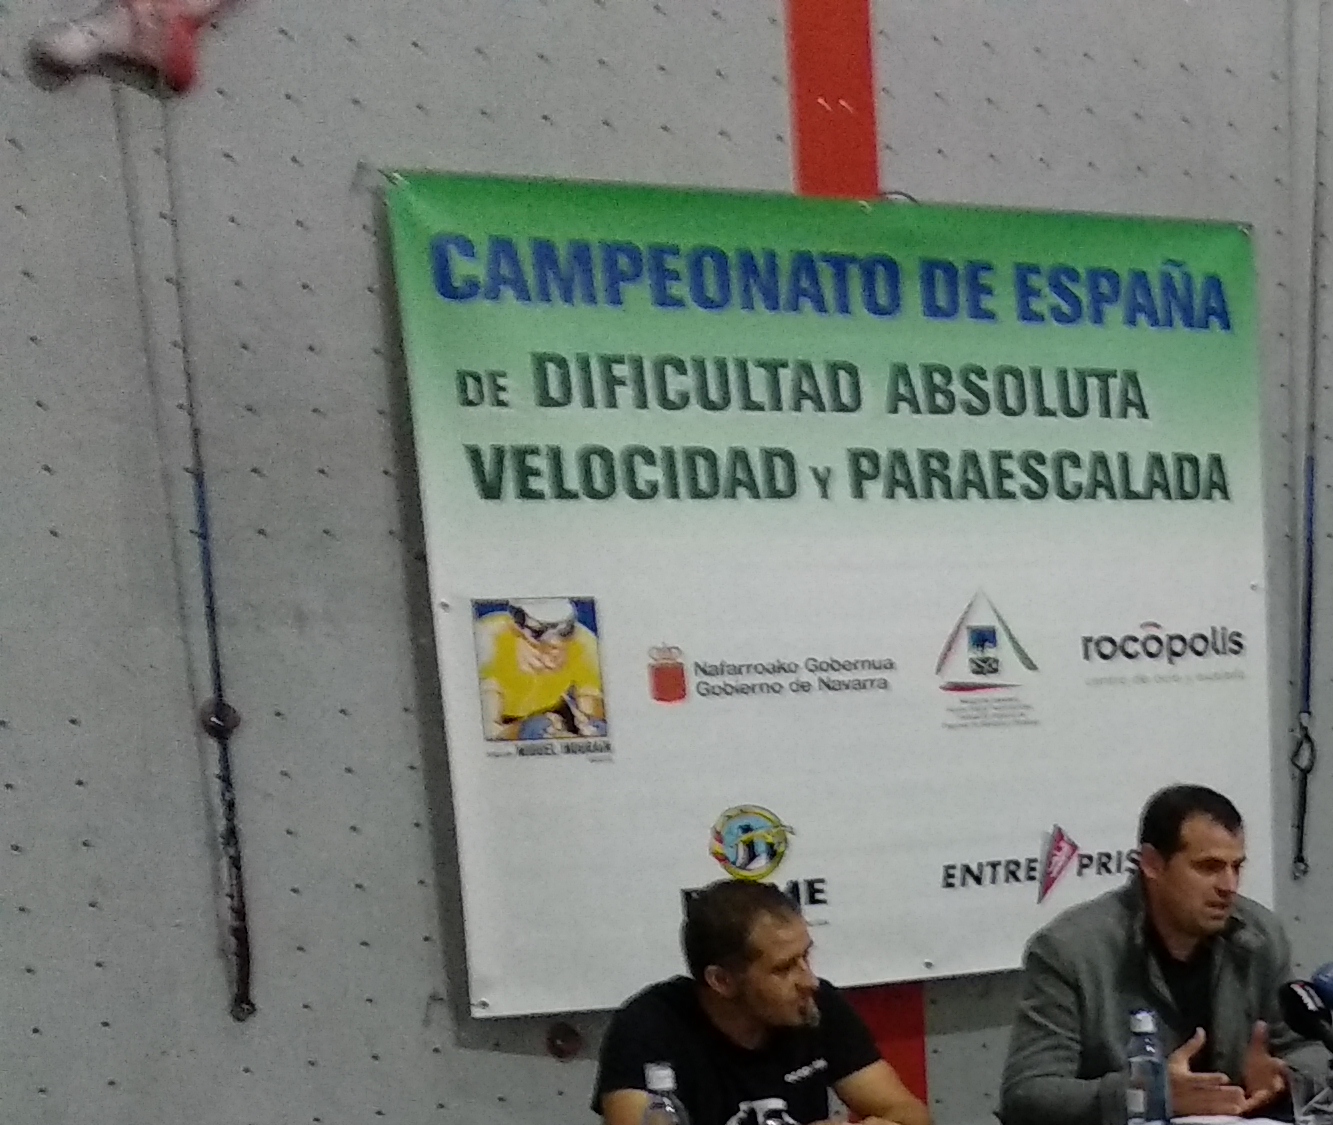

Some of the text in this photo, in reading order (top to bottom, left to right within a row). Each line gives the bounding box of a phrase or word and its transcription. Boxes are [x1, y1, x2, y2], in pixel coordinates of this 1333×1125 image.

[431, 232, 1232, 332] CAMPEONATO DE ESPAÑA
[456, 352, 1151, 421] DE DIFICULTAD ABSOLUTA
[465, 444, 1231, 501] VELOCIDAD Y PARAESCALADA
[693, 656, 896, 677] Nafarroako Gobernua
[696, 675, 889, 697] Gobierno de Navarra
[941, 857, 1039, 889] ENTRE
